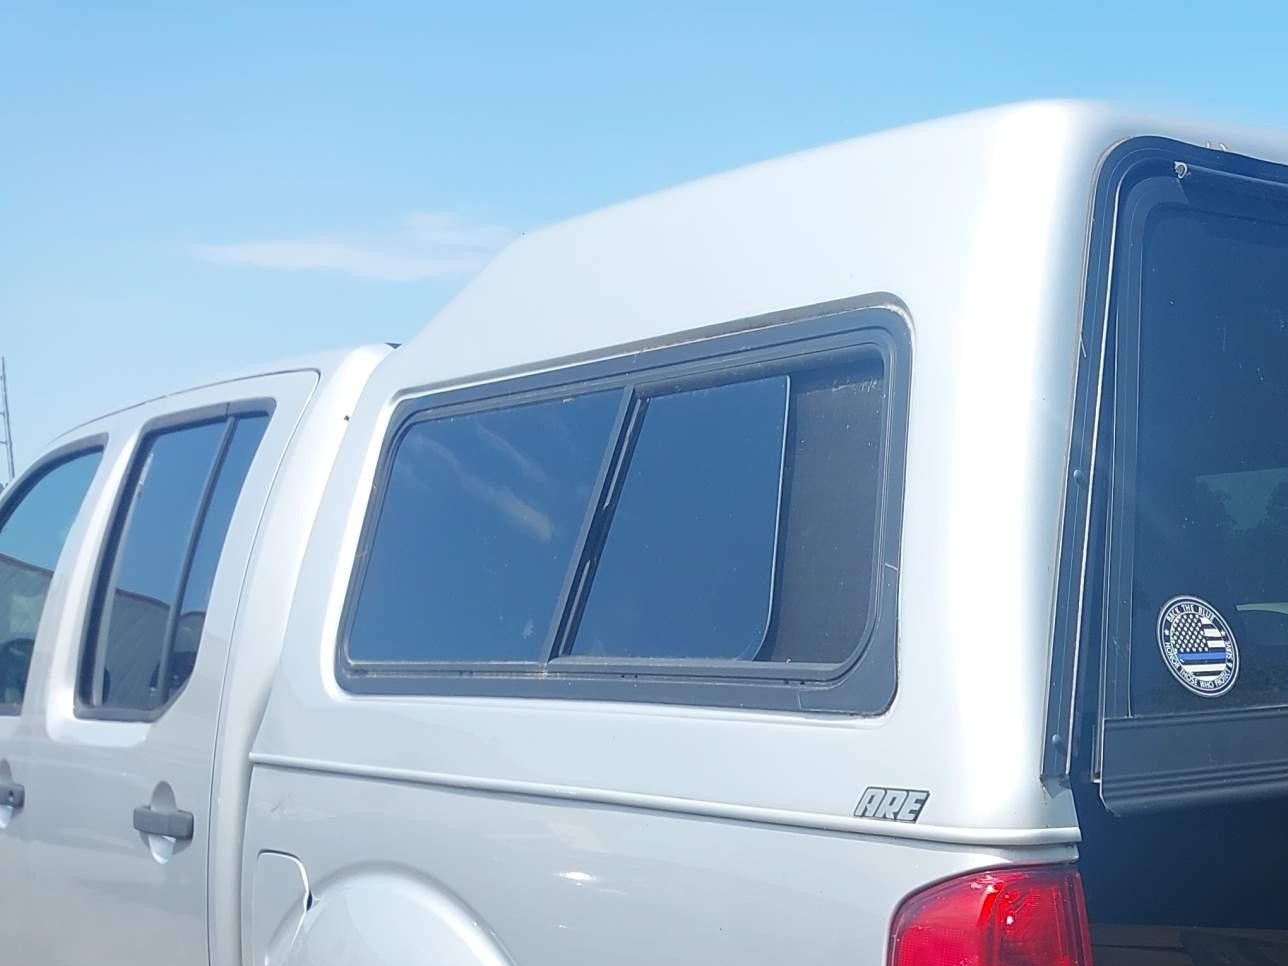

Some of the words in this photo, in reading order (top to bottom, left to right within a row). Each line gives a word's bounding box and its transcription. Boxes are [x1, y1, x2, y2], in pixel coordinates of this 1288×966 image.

[1166, 606, 1181, 622] BACK
[1181, 603, 1194, 613] THE
[1198, 606, 1215, 622] BLUE
[1165, 642, 1180, 669] HONOR
[1179, 668, 1198, 686] THOSE
[1200, 680, 1214, 688] WHO
[854, 786, 930, 823] ARE
